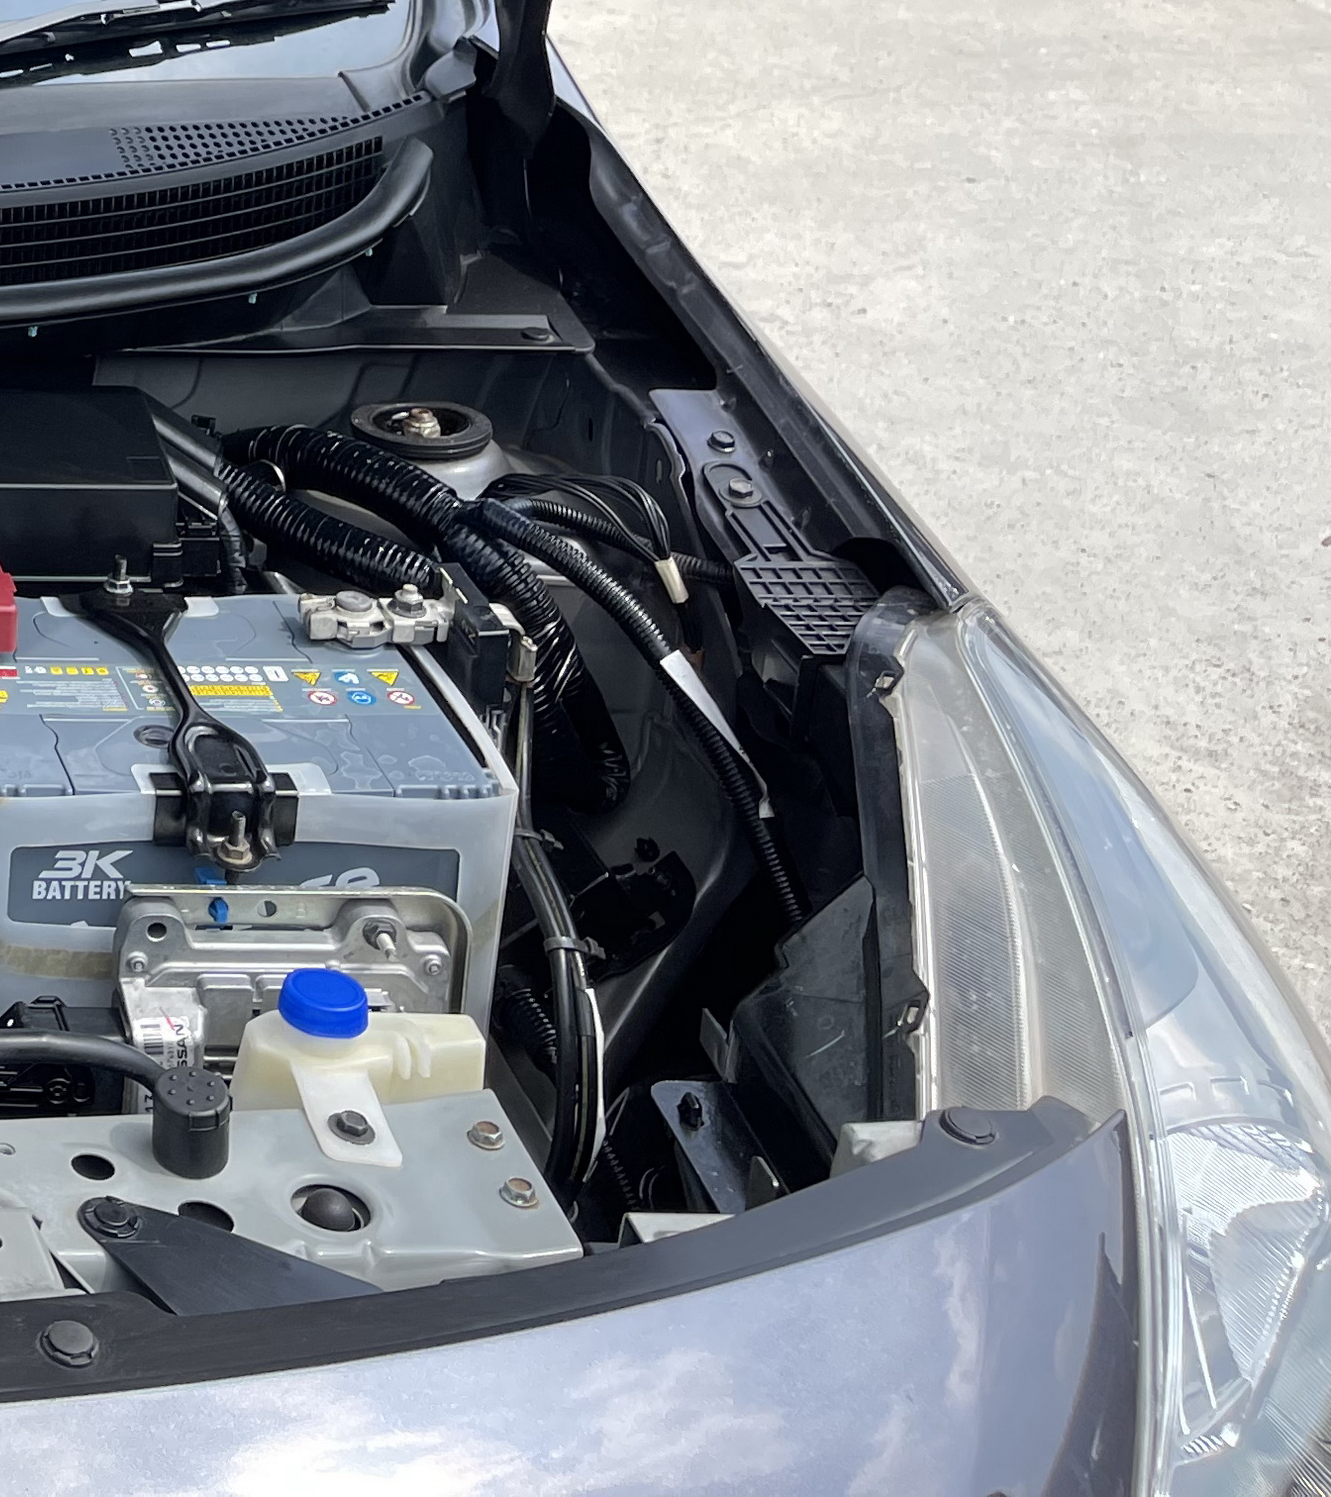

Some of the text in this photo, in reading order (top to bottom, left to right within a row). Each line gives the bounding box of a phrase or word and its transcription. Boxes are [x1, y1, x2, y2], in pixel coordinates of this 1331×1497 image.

[39, 849, 134, 879] 3K
[32, 880, 131, 901] BATTERY
[173, 1024, 188, 1067] SSAN
